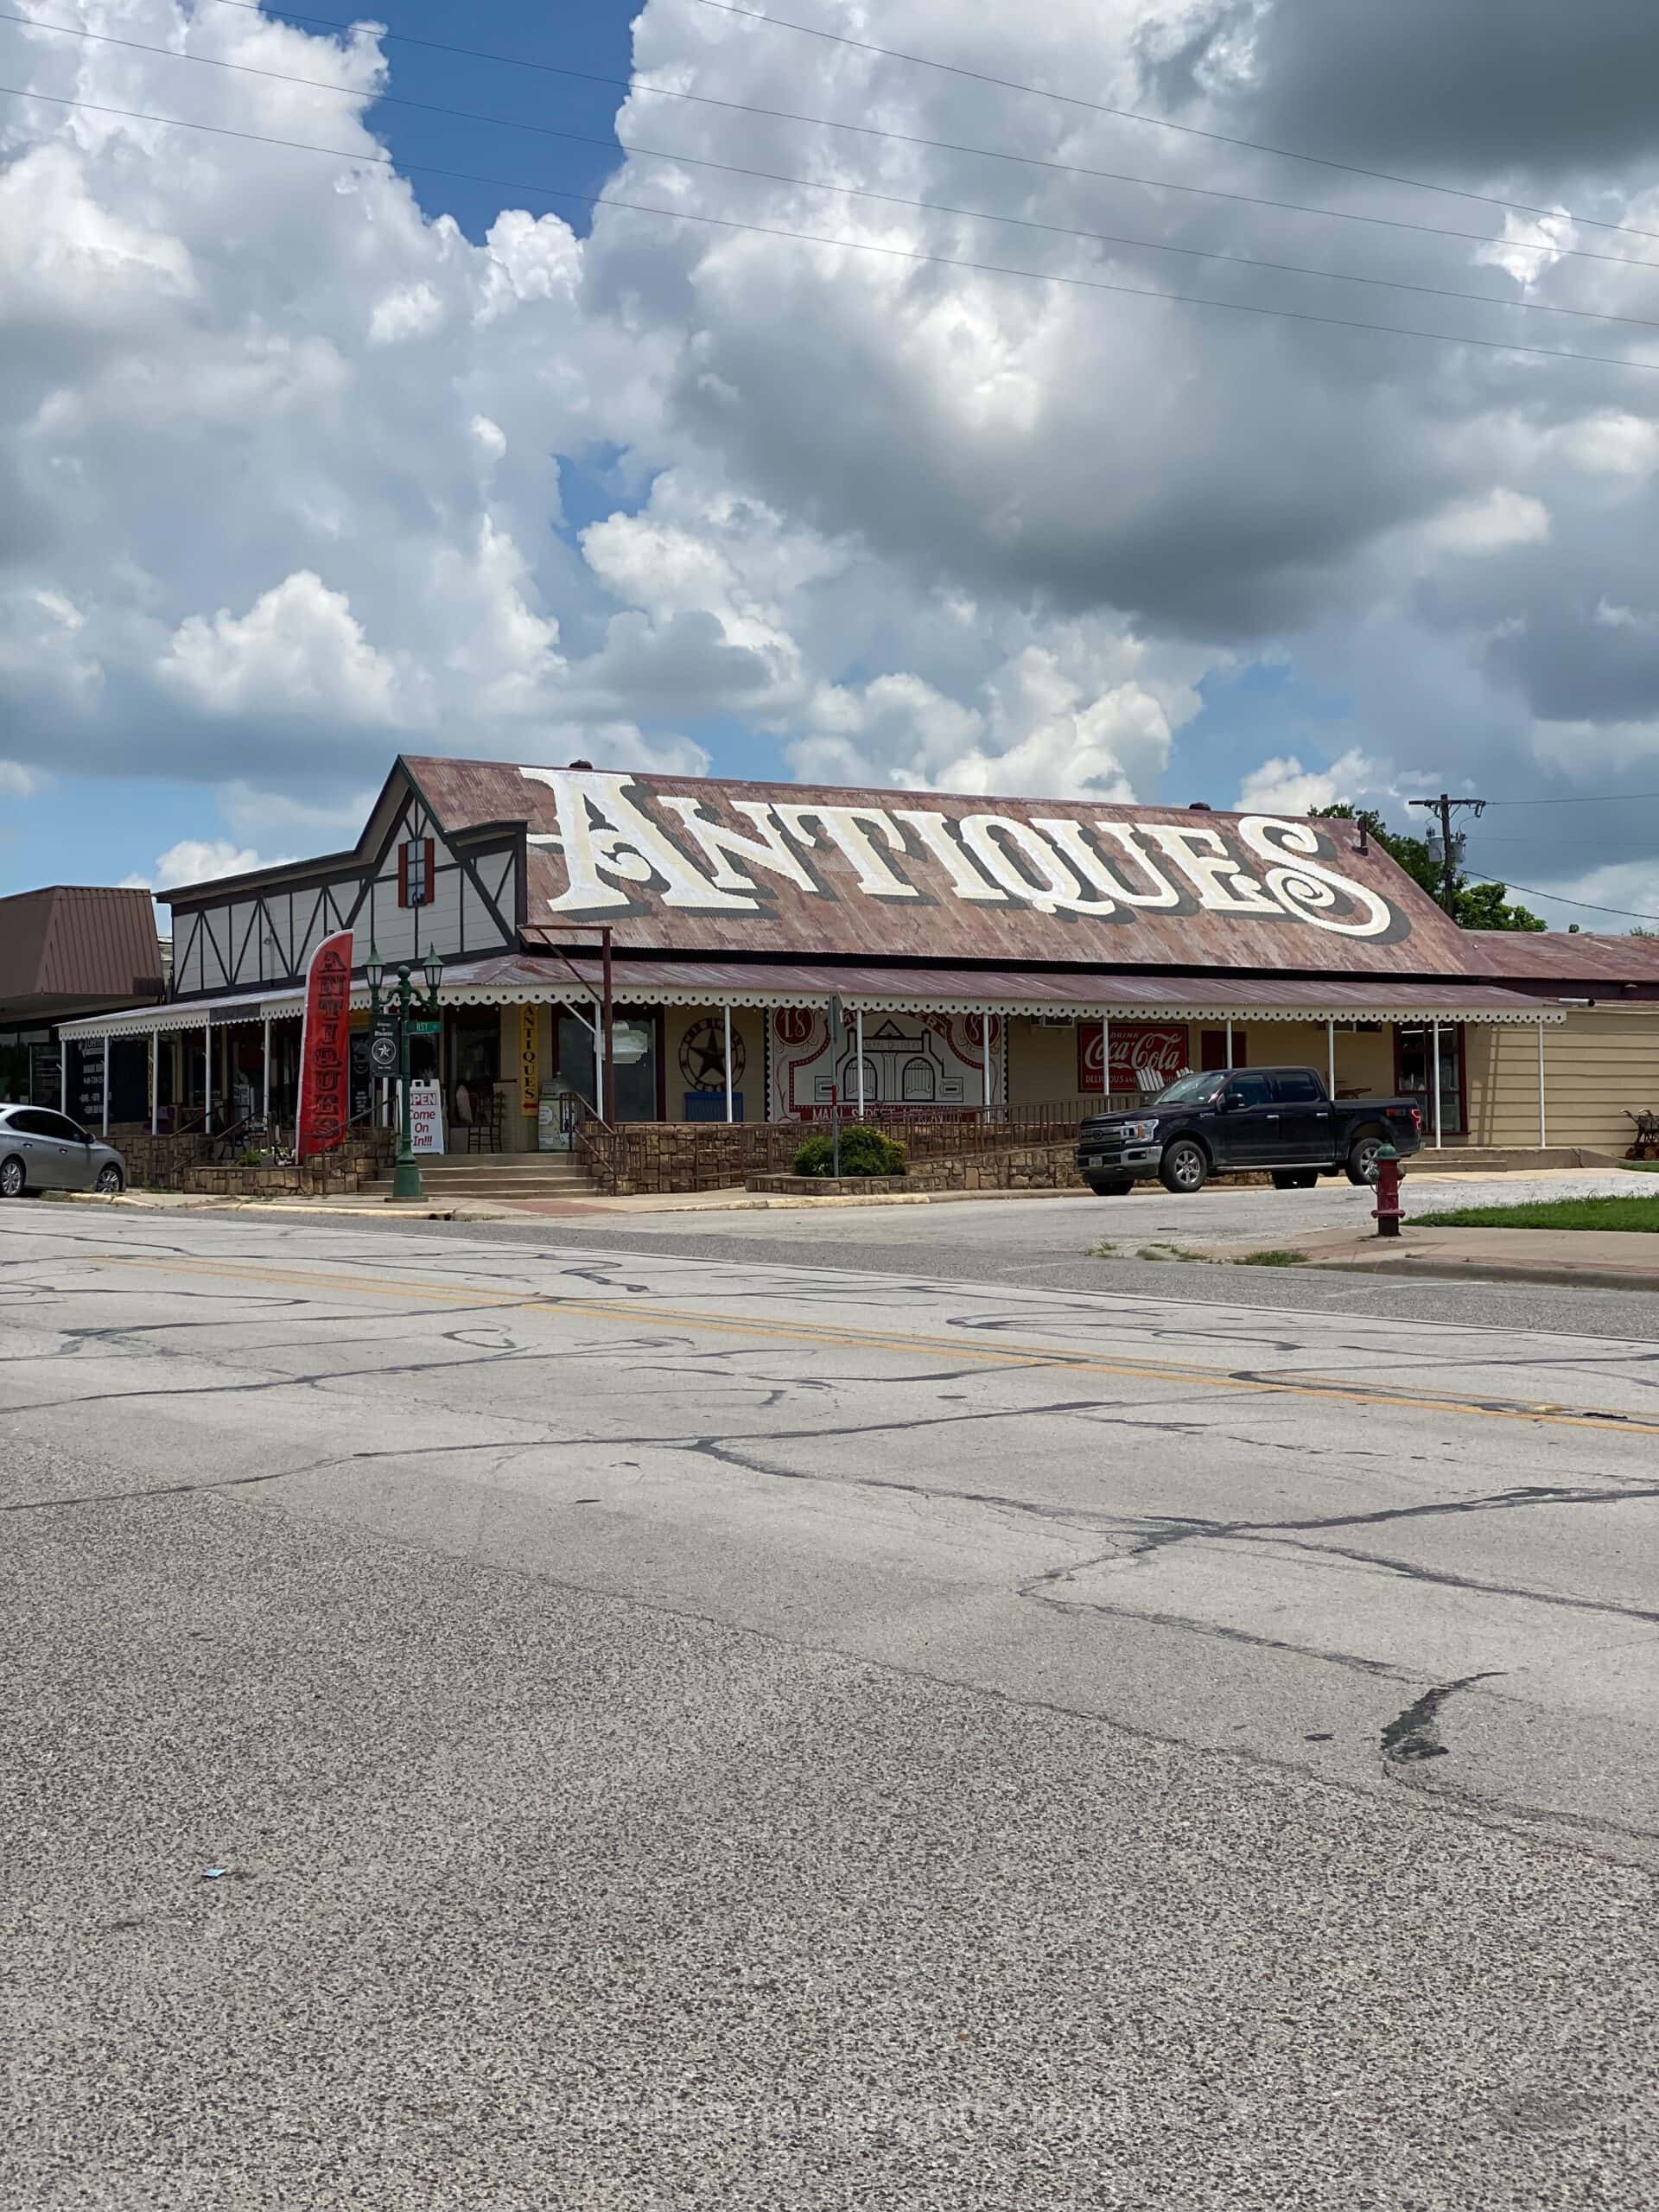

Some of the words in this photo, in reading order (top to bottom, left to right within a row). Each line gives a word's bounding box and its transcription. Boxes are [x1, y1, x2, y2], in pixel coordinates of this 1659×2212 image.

[518, 766, 1391, 938] ANTIQUES
[314, 951, 347, 1139] ANTIQUES
[522, 1004, 537, 1100] ANTIQUES
[413, 1135, 433, 1147] In!!!
[415, 1122, 429, 1133] On
